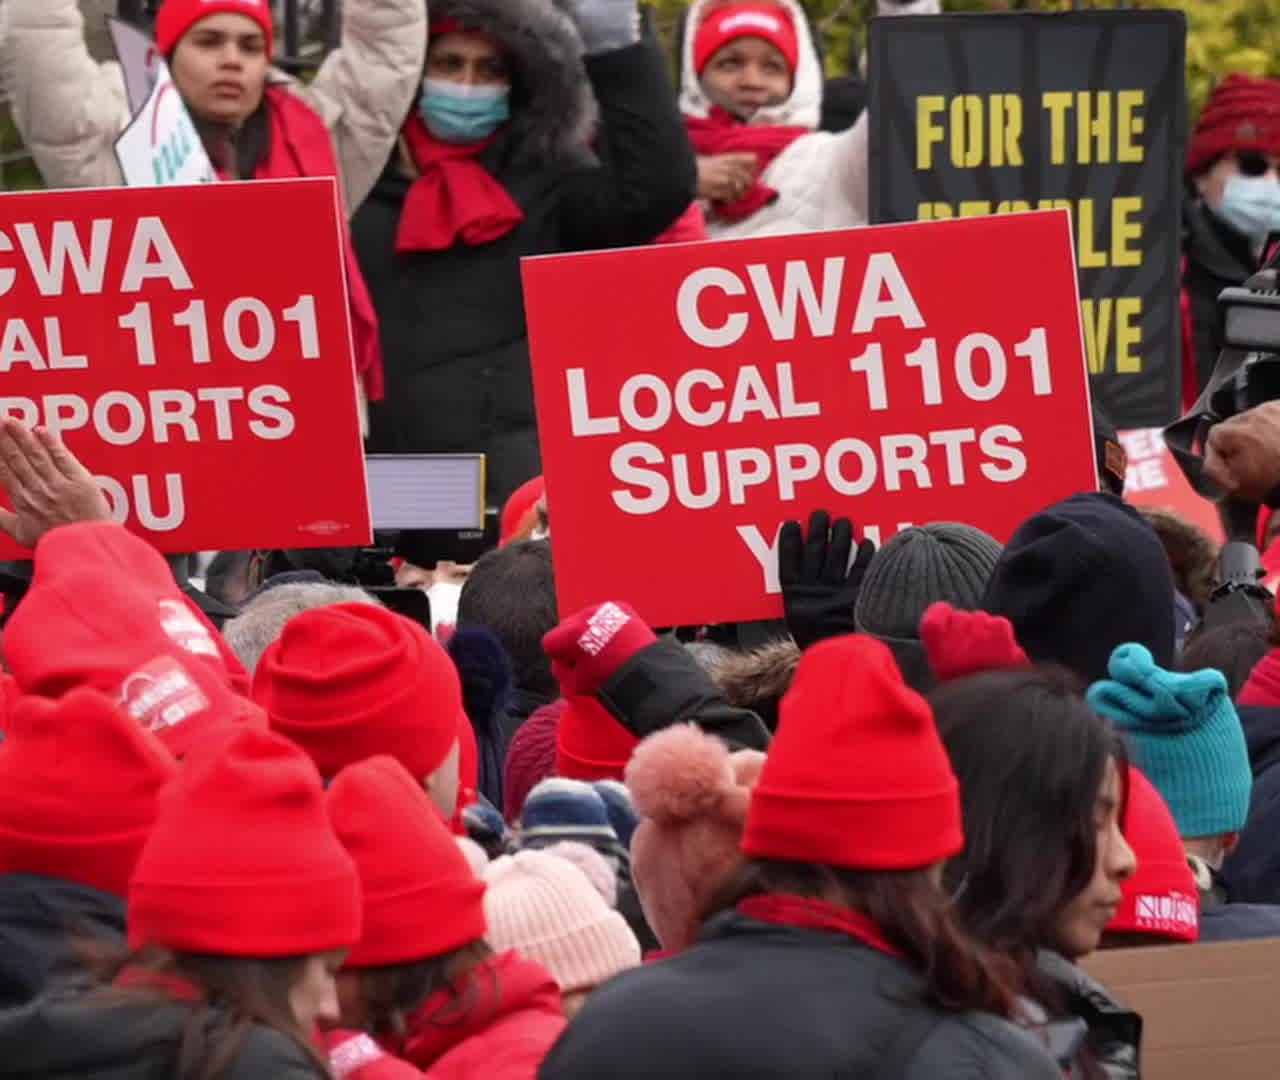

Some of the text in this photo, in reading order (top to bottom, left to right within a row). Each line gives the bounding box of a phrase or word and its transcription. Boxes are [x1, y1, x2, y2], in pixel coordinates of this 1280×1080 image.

[915, 88, 1146, 171] FOR THE
[118, 294, 321, 367] 1101
[675, 251, 926, 348] CWA
[849, 327, 1055, 411] 1101
